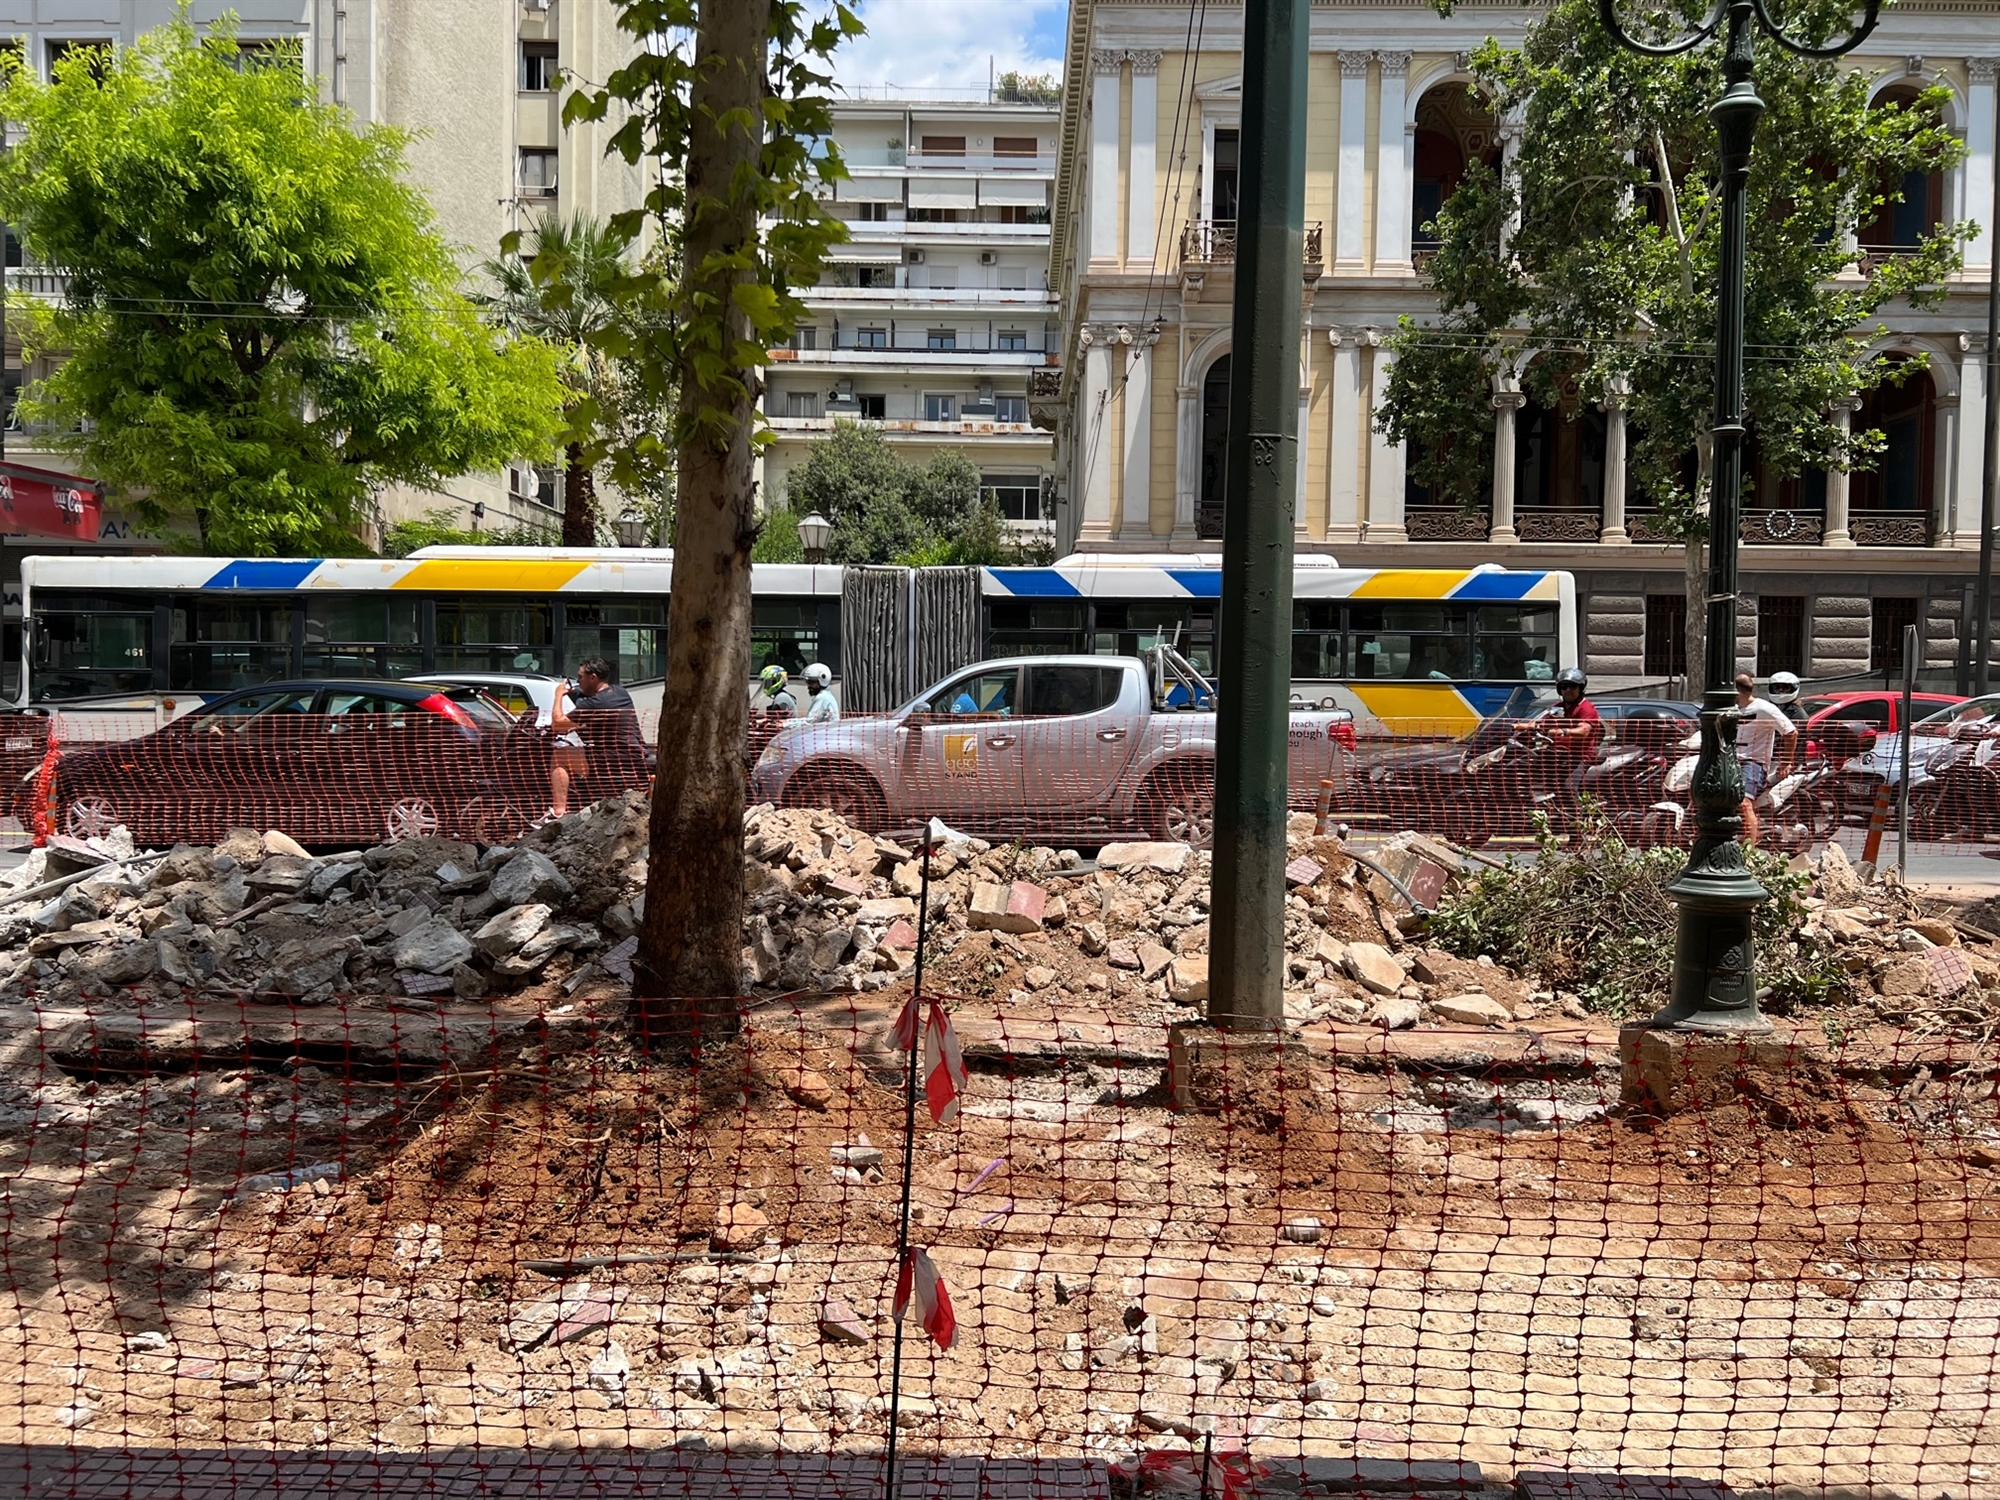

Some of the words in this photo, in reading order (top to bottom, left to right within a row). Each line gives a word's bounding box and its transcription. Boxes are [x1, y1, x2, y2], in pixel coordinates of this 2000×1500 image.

[125, 648, 143, 657] 461
[1291, 720, 1314, 728] reach
[1289, 728, 1322, 740] nough
